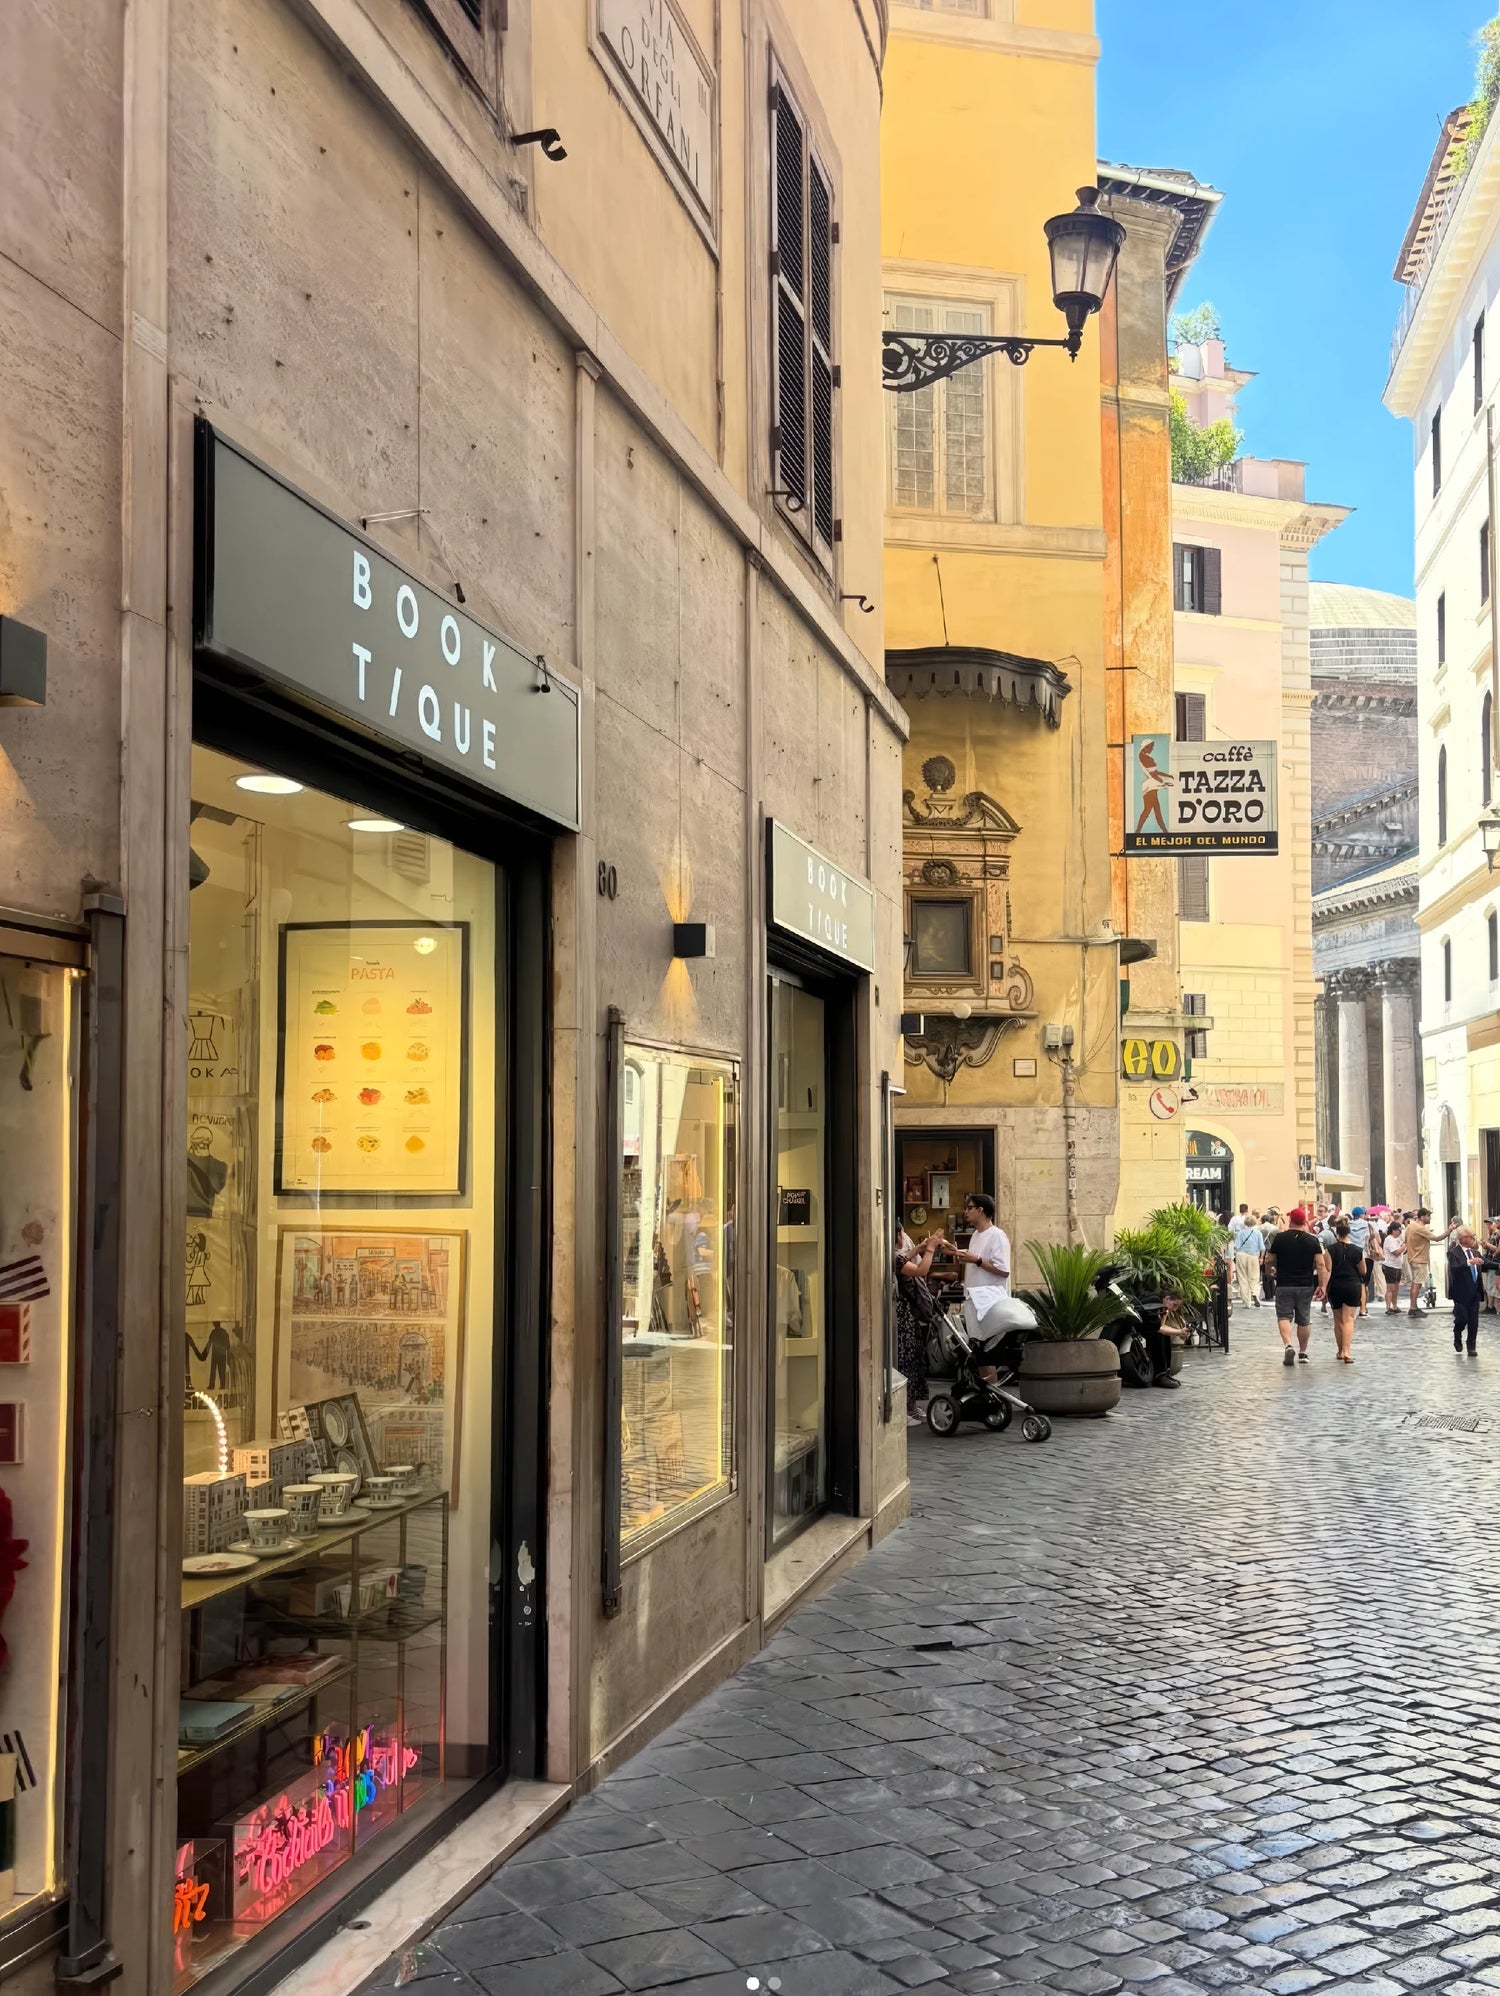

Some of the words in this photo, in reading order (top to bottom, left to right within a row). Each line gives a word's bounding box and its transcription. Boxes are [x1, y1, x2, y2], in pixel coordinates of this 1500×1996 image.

[641, 17, 681, 109] DEGLI
[621, 26, 699, 187] ORFANI
[353, 550, 498, 694] BOOK
[1202, 745, 1254, 763] caffè
[1179, 769, 1266, 794] TAZZA
[1178, 798, 1264, 824] D'ORO
[1136, 837, 1148, 846] EL
[1151, 836, 1192, 846] MEJOR
[1197, 836, 1217, 845] DEL
[1222, 836, 1266, 845] MUNDO
[599, 860, 617, 901] 80
[807, 856, 847, 909] BOOK
[351, 967, 395, 980] PASTA
